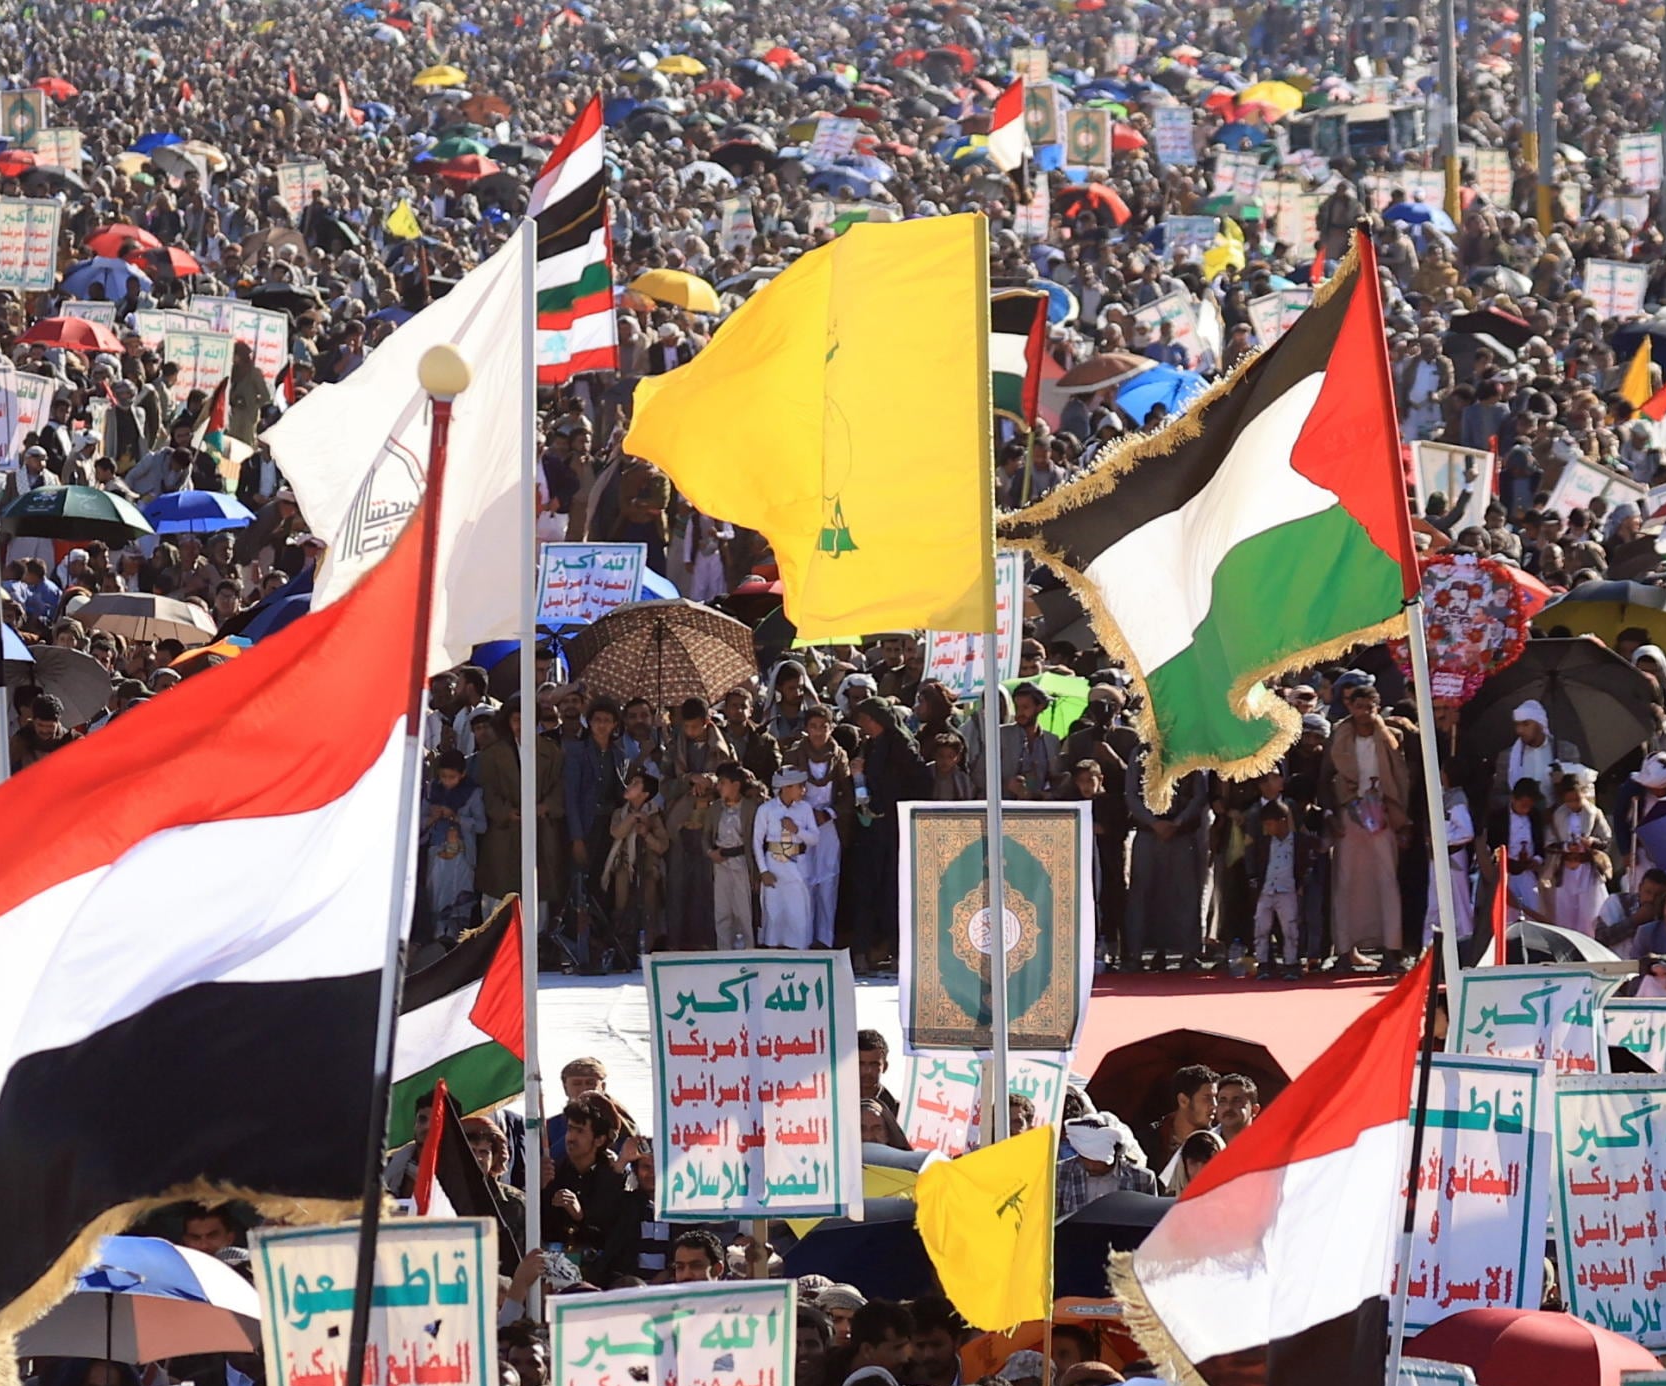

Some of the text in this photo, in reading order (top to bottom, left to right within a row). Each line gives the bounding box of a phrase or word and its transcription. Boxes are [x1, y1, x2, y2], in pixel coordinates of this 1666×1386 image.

[665, 967, 824, 1026] الله أكبر
[757, 1027, 825, 1062] الموت
[758, 1072, 826, 1107] الموت
[672, 1117, 828, 1153] اللعنة على اليهود
[1566, 1096, 1661, 1162] أكبر
[758, 1156, 829, 1208] النصر
[1576, 1255, 1636, 1292] اليهود
[568, 1303, 777, 1372] الله أكبر
